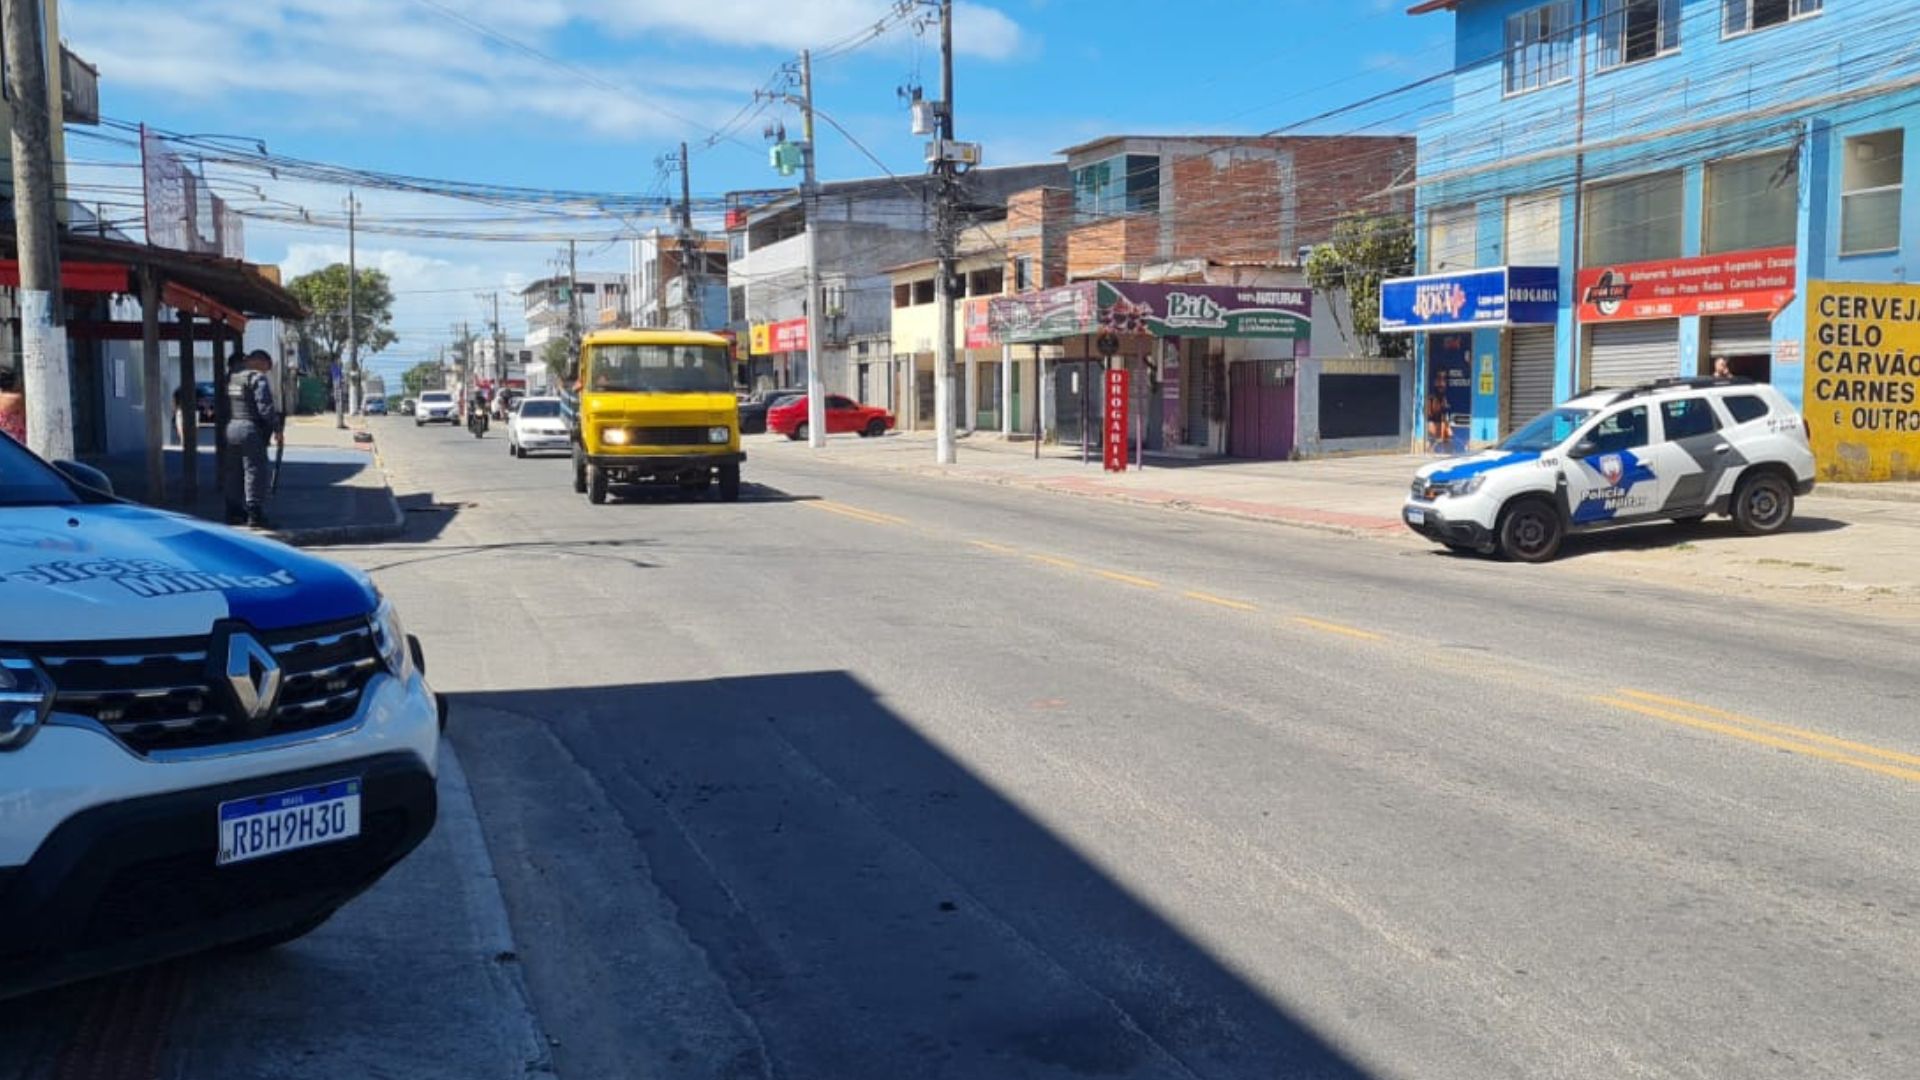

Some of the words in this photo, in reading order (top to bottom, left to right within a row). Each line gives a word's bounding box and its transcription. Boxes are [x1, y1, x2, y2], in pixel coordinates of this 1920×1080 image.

[1256, 292, 1304, 305] NATURAL
[1510, 288, 1557, 303] DROGARIA
[1818, 323, 1882, 347] GELO
[1816, 378, 1914, 403] CARNES
[1111, 373, 1122, 467] DROGARIA
[113, 570, 296, 598] Militar
[233, 802, 345, 856] RBH9H30
